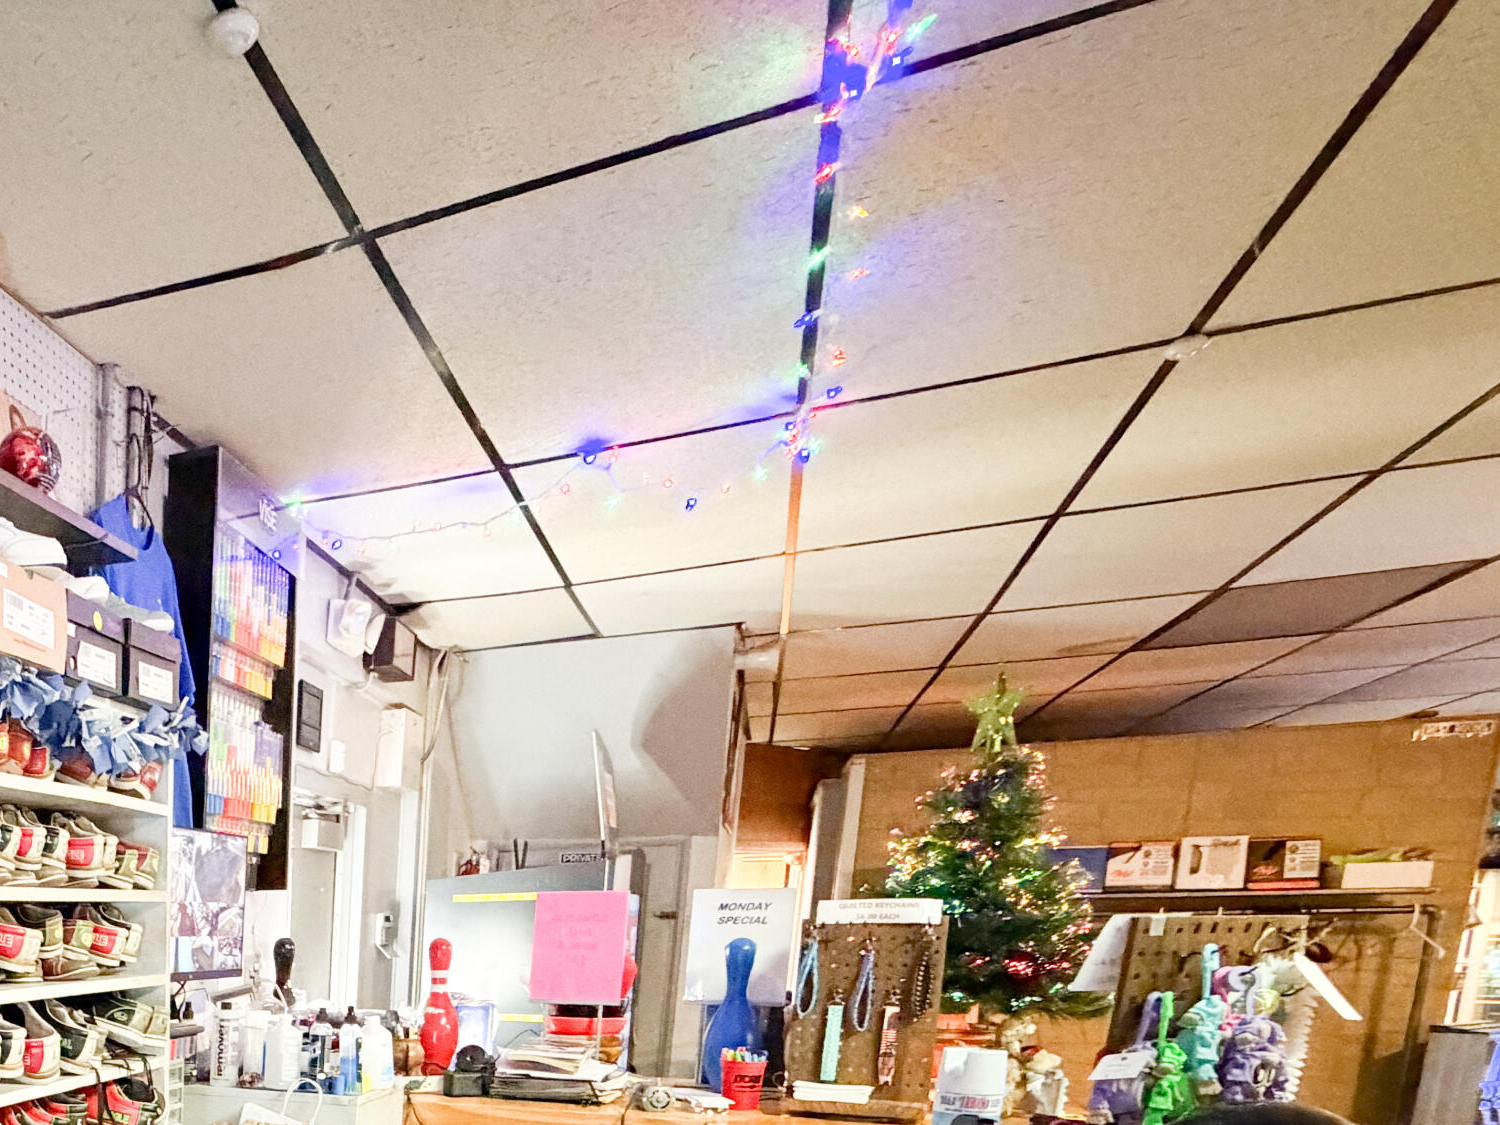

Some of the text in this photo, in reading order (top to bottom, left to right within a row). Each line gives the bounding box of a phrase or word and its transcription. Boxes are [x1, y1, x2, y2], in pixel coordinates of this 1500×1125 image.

[717, 902, 773, 912] MONDAY
[716, 916, 769, 925] SPECIAL
[216, 1023, 224, 1077] remover
